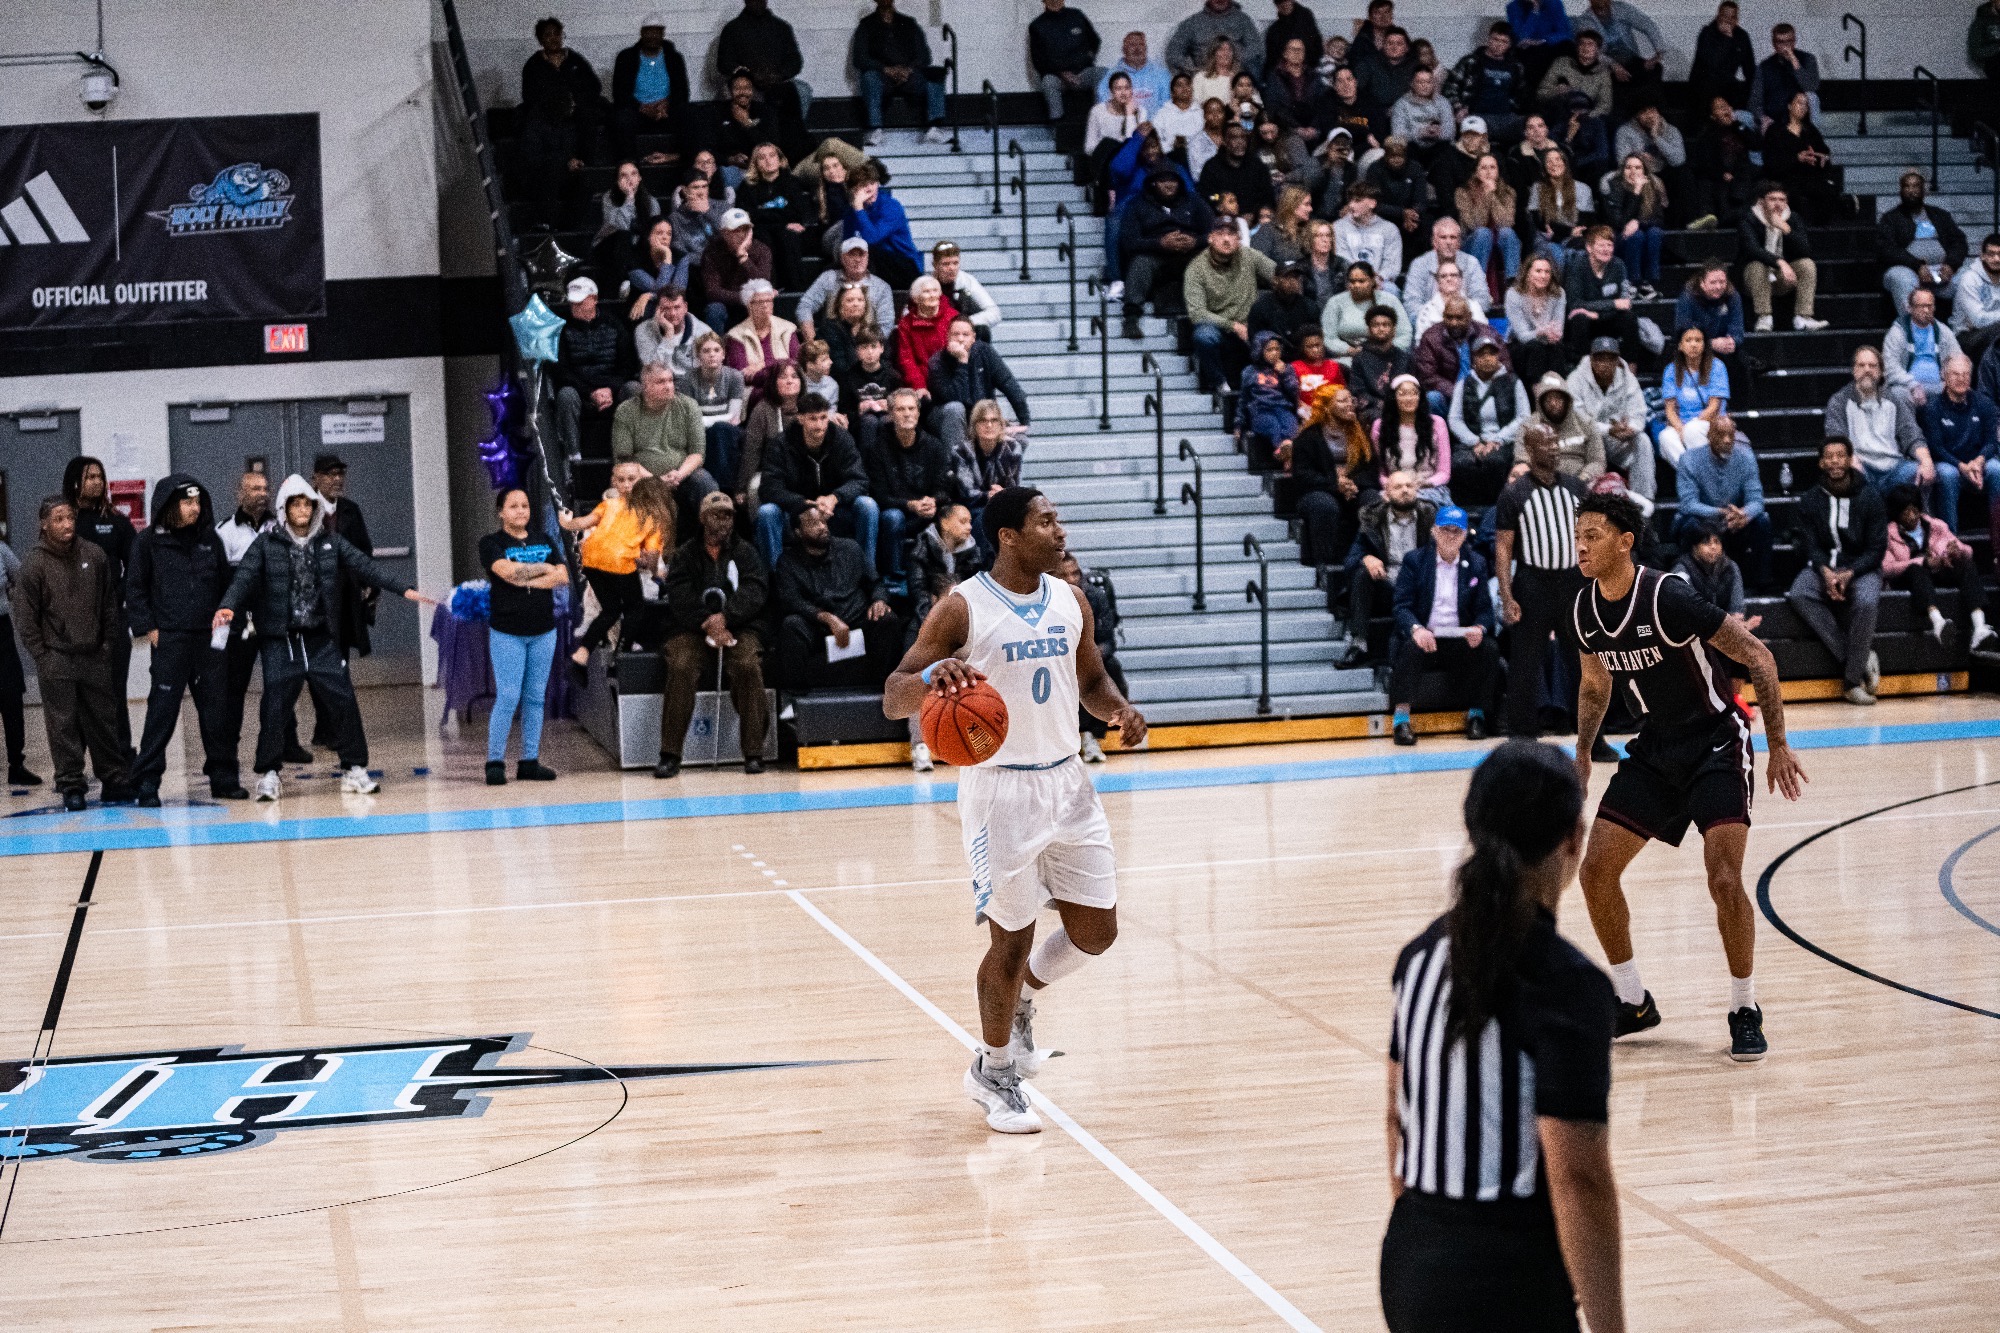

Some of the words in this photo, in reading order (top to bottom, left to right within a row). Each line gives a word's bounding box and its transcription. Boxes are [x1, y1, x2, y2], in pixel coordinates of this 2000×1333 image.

[171, 205, 220, 225] HOLY
[32, 285, 111, 308] OFFICIAL
[114, 280, 208, 304] OUTFITTER
[269, 326, 305, 352] EXIT
[1001, 637, 1069, 663] TIGERS
[1593, 650, 1622, 671] OCK
[1619, 645, 1664, 671] HAVEN
[1031, 666, 1052, 705] 0
[1628, 678, 1650, 714] 1
